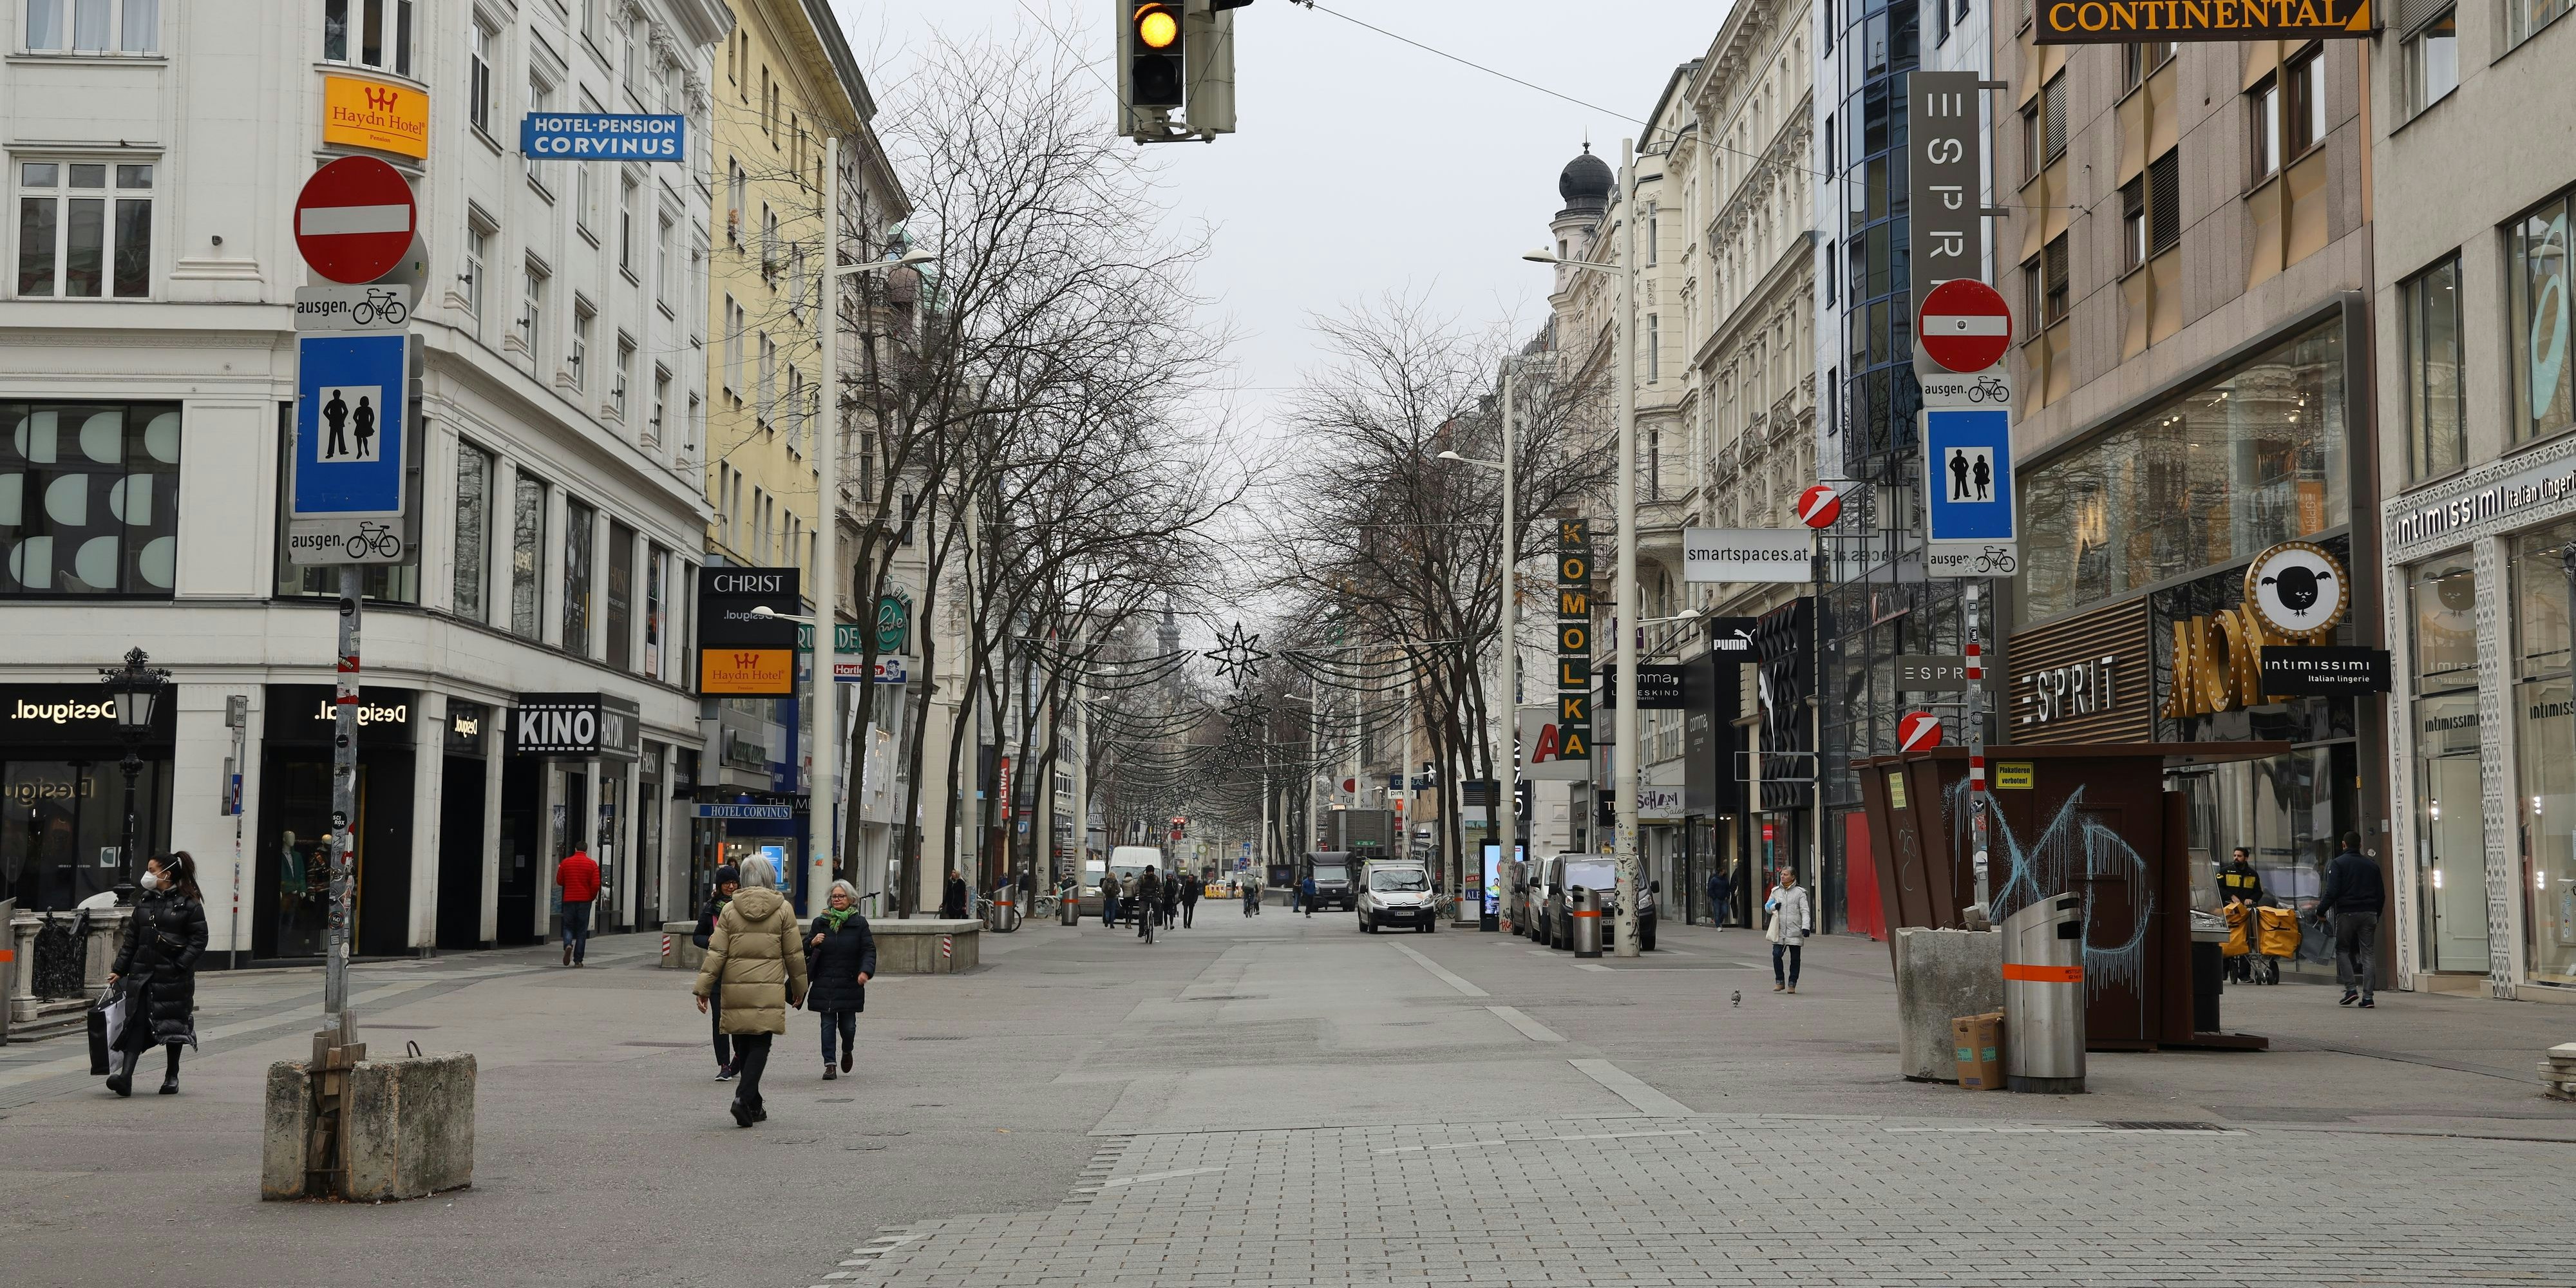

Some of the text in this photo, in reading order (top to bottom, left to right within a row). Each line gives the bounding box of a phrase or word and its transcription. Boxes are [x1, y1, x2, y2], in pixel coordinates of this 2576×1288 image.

[2049, 0, 2349, 32] CONTINENTAL
[332, 106, 384, 127] Haydn
[534, 117, 676, 134] HOTEL-PENSION
[370, 134, 392, 144] Pension
[534, 136, 676, 155] CORVINUS
[297, 300, 352, 317] ausgen.
[1924, 384, 1967, 397] ausgen.
[2396, 486, 2505, 545] intimissimi
[2506, 484, 2540, 509] Italian
[291, 534, 345, 551] ausgen.
[1688, 547, 1808, 564] smartspaces.at
[714, 574, 784, 592] CHRIST
[1562, 522, 1586, 755] KOMOLKA
[1713, 638, 1748, 650] PUMA
[835, 665, 882, 675] Hartler
[2265, 659, 2370, 670] intimissimi
[712, 669, 748, 683] Haydn
[1904, 667, 1989, 680] ESPRT
[2337, 675, 2370, 684] lingerie
[2022, 655, 2119, 723] ESPRIT
[518, 710, 596, 745] KINO
[601, 712, 624, 749] HAYDN
[1689, 713, 1708, 733] comma,
[639, 750, 656, 774] CHRIST
[1999, 766, 2031, 774] Plakatieren
[1390, 790, 1414, 798] pime
[711, 806, 741, 817] HOTEL
[743, 806, 789, 817] CORVINUS
